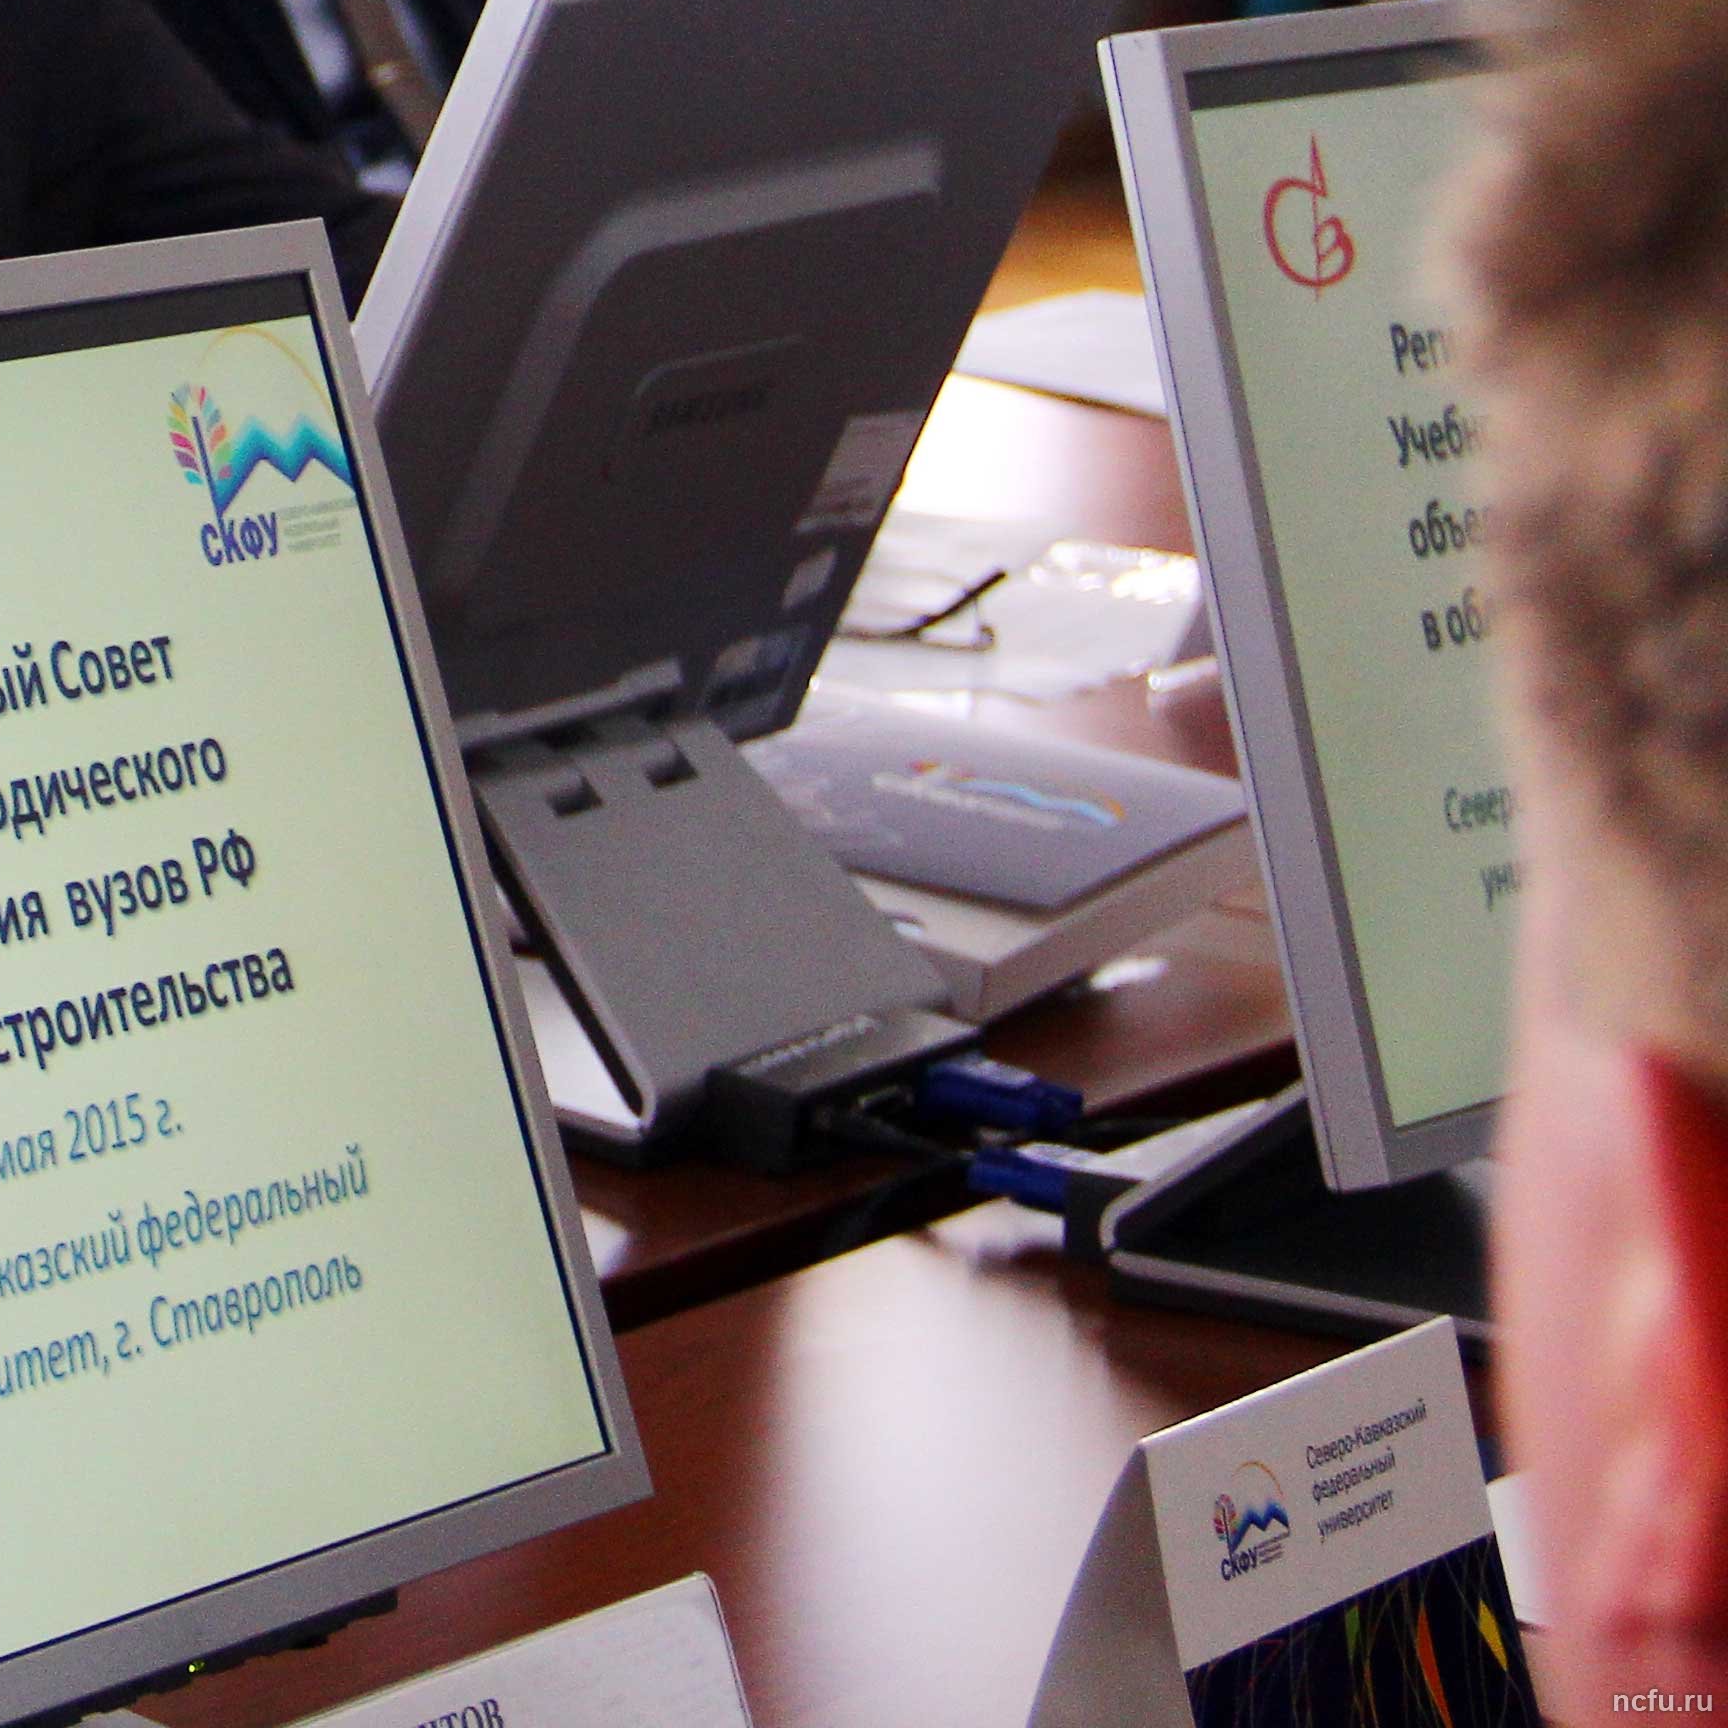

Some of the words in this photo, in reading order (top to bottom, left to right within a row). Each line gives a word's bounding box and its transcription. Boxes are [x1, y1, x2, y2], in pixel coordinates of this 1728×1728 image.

[201, 512, 279, 566] СКФУ
[51, 635, 176, 701] Совет
[66, 857, 190, 937] вузов
[192, 828, 257, 896] РФ
[63, 1092, 148, 1162] 2015
[155, 1098, 184, 1137] г.
[137, 1143, 370, 1260] федеральный
[115, 1320, 144, 1360] г.
[149, 1252, 364, 1349] Ставрополь
[1305, 1398, 1428, 1470] Северо-Кавказский
[1311, 1447, 1396, 1506] федеральный
[1317, 1489, 1395, 1544] университет
